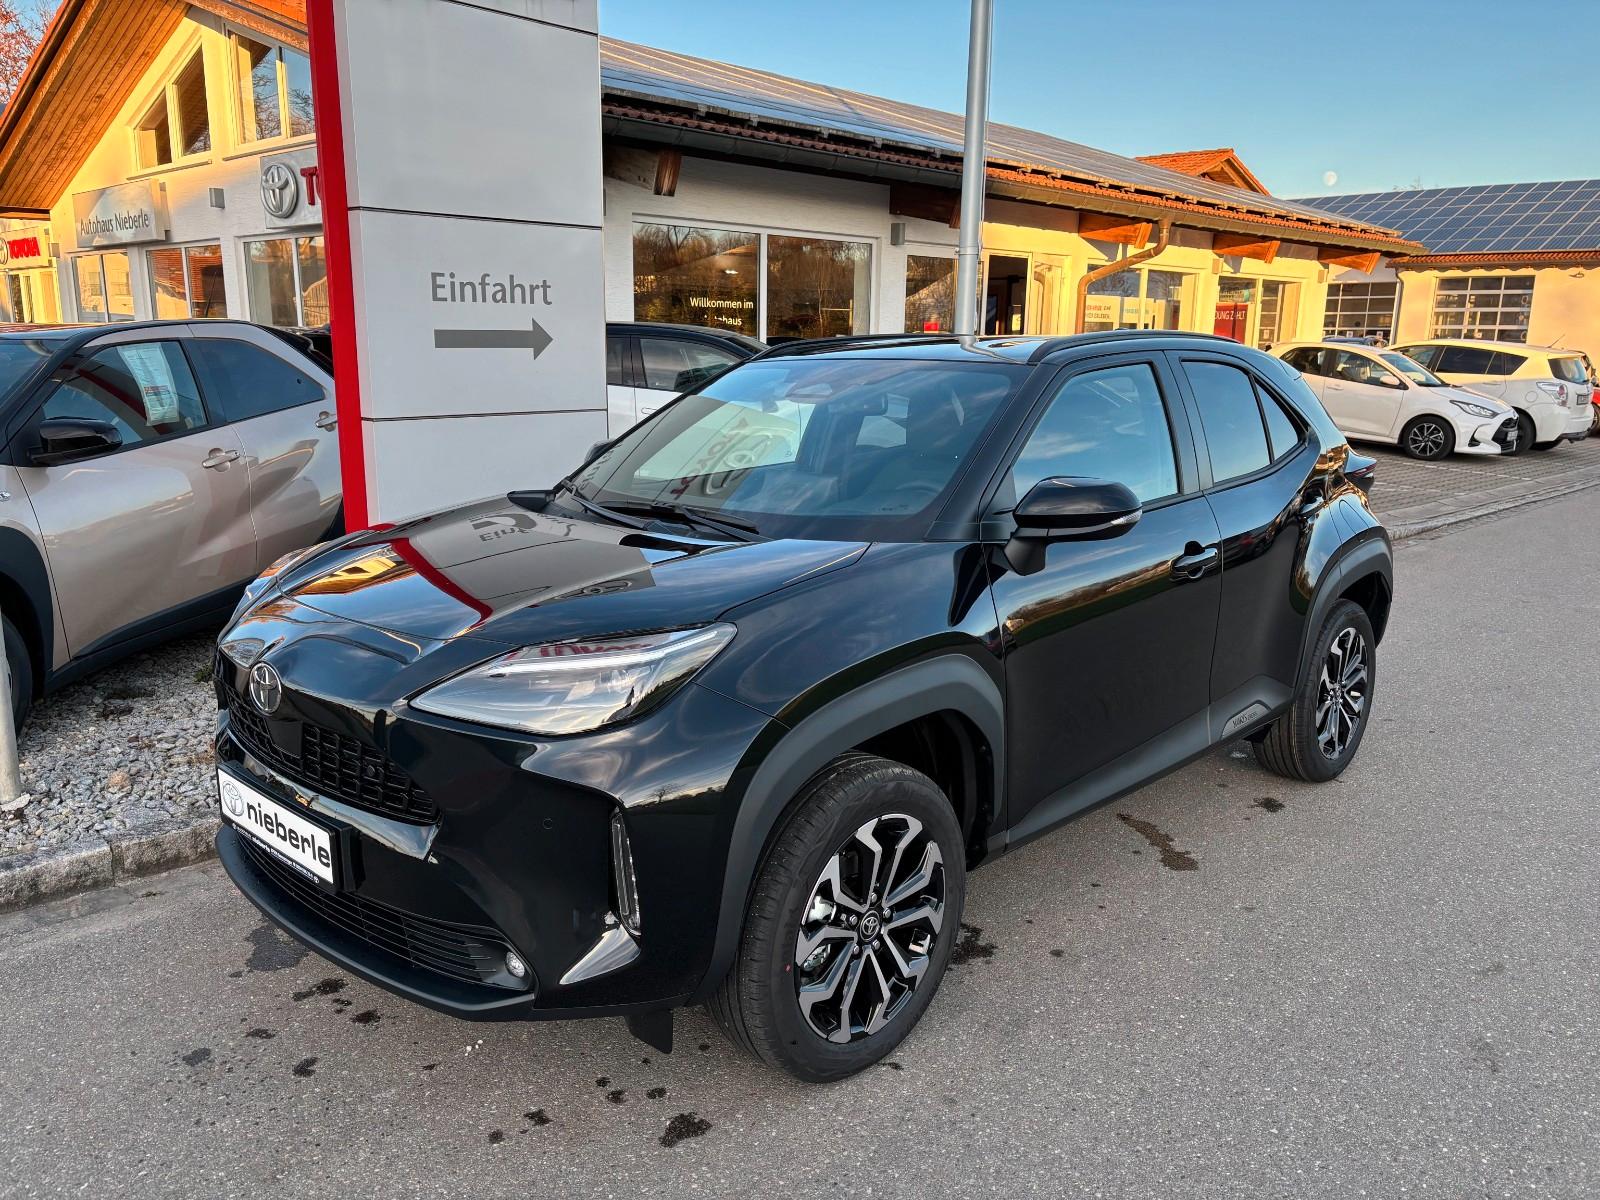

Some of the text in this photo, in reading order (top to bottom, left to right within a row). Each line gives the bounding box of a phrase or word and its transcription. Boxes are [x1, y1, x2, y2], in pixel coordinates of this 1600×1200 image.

[80, 208, 150, 236] Autohaus Nieberle
[7, 236, 41, 259] TOYOTA
[430, 271, 553, 306] Einfahrt
[689, 296, 754, 309] Willkommen im
[246, 801, 331, 869] nieberle
